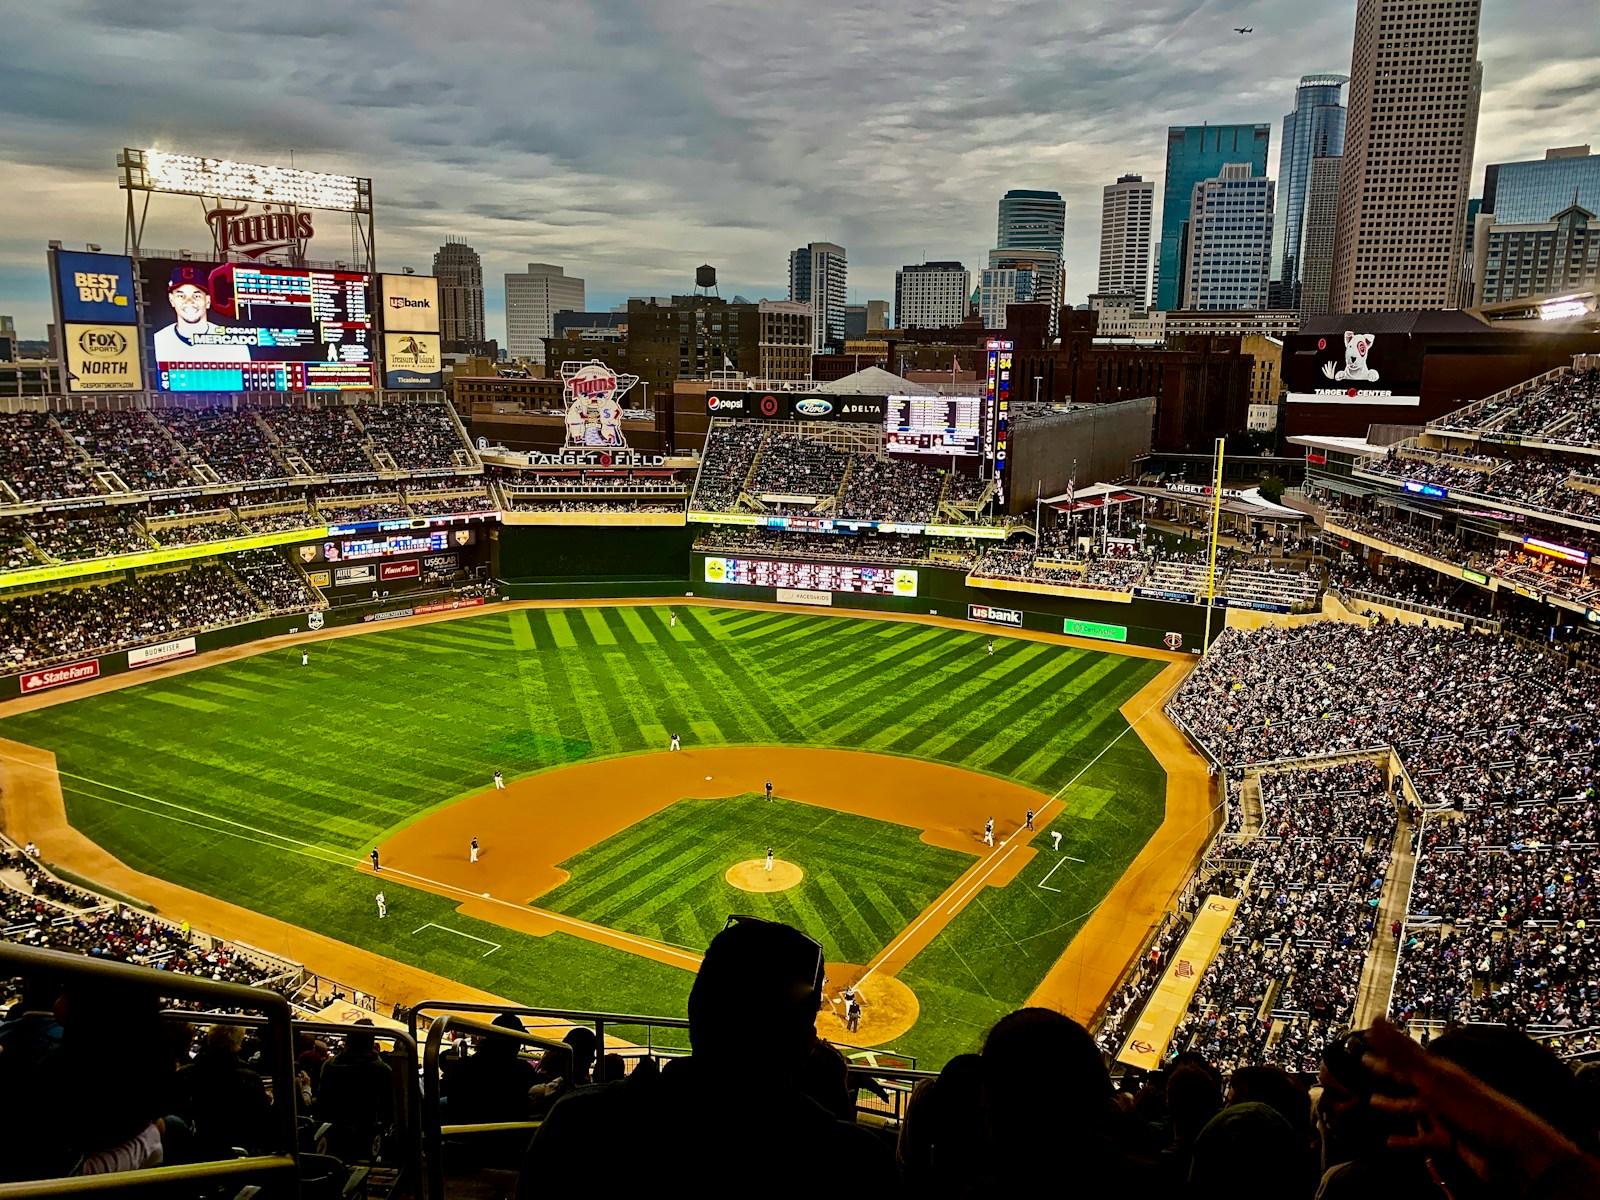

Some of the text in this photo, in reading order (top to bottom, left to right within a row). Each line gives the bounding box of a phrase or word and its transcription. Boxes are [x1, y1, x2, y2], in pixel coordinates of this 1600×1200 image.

[205, 203, 315, 254] Twins
[74, 272, 119, 289] BEST
[79, 287, 117, 303] BUY
[88, 333, 117, 347] FOX
[193, 335, 258, 345] MERCADO
[391, 354, 435, 363] Treasure Island
[1000, 359, 1012, 369] 34
[82, 361, 128, 375] NORTH
[567, 375, 617, 401] Twins
[1314, 388, 1392, 397] TARGET CENTER
[720, 399, 743, 410] pepsi
[803, 402, 825, 414] Ford
[851, 404, 881, 413] DELTA
[529, 455, 665, 466] TARGET FIELD
[1165, 482, 1243, 497] TARGET FIELD
[144, 642, 180, 657] BUDWEISER
